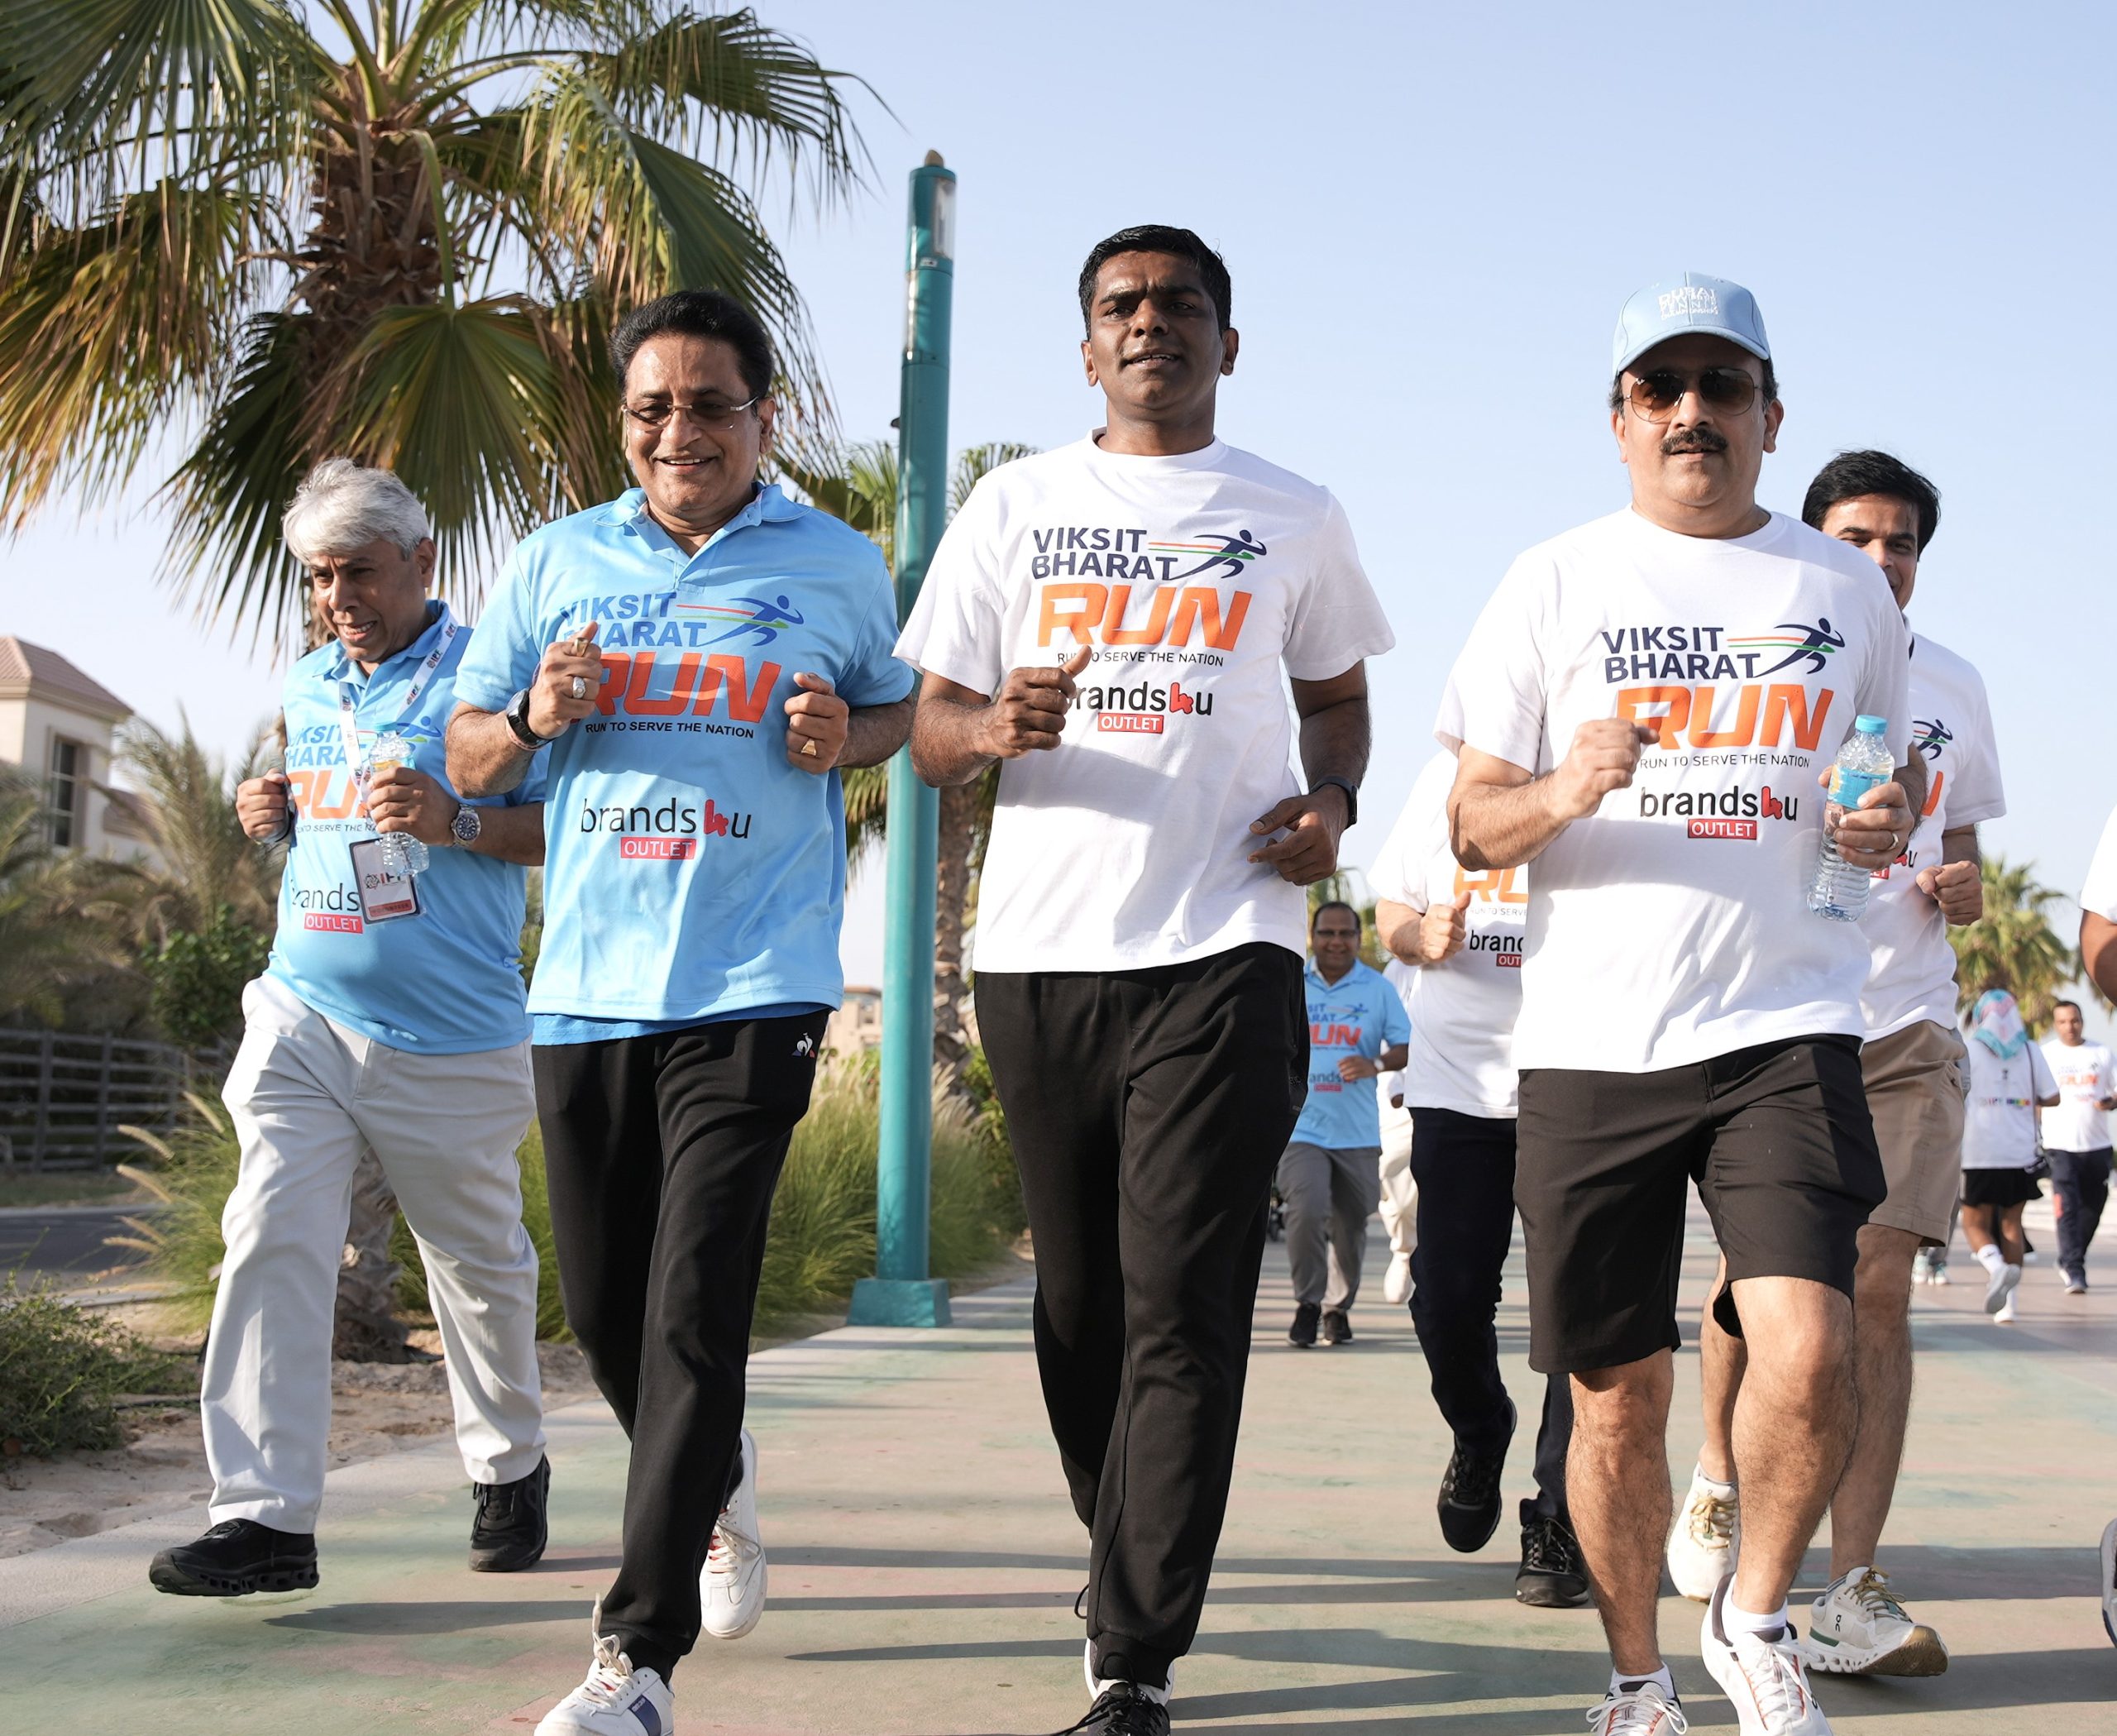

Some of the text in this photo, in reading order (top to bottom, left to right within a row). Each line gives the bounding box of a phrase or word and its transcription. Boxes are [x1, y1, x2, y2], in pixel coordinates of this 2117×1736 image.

[1033, 527, 1147, 553] VIKSIT
[1032, 552, 1178, 581] BHARAT
[560, 591, 676, 627] VIKSIT
[1038, 583, 1252, 652] RUN
[1602, 626, 1724, 654] VIKSIT
[1104, 652, 1145, 662] SERVE
[1149, 652, 1173, 662] THE
[1179, 653, 1224, 667] NATION
[1604, 653, 1761, 684] BHARAT
[1076, 681, 1213, 715] rands4u
[1101, 716, 1160, 731] OUTLET
[1616, 684, 1834, 752] RUN
[585, 721, 753, 739] RUN TO SERVE THE NATION
[286, 744, 365, 768] HARA
[1641, 753, 1809, 768] RUN TO SERVE THE NATION
[286, 769, 367, 820] RU
[313, 824, 341, 832] SERVE
[345, 824, 362, 832] THE
[1691, 821, 1753, 837] OUTLET
[624, 839, 692, 858] OUTLET
[306, 915, 358, 930] OUTLET
[1498, 955, 1522, 965] OUT
[1310, 1023, 1362, 1046] UN
